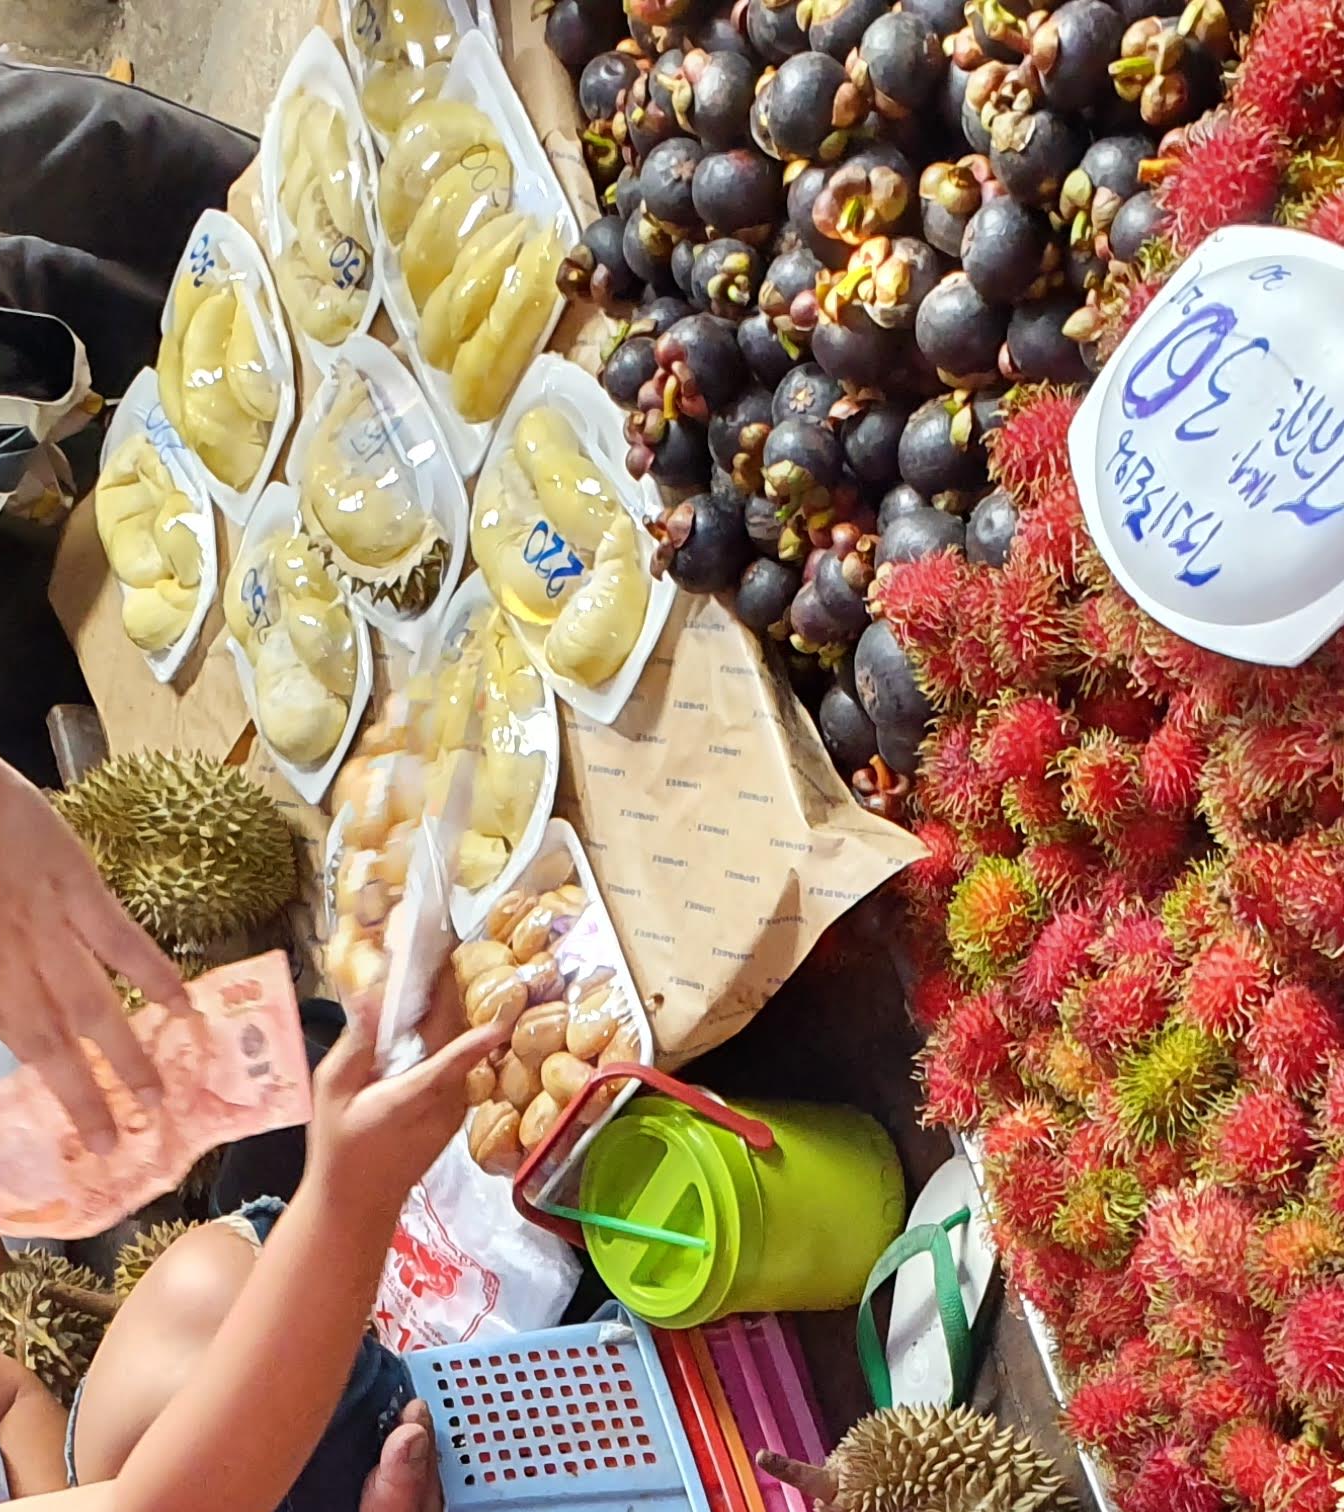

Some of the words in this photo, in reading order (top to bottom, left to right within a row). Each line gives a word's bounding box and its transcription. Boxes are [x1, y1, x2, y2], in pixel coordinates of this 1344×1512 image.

[328, 236, 367, 291] 50
[1249, 264, 1292, 292] 30
[1122, 302, 1272, 442] 30
[520, 520, 585, 599] 220
